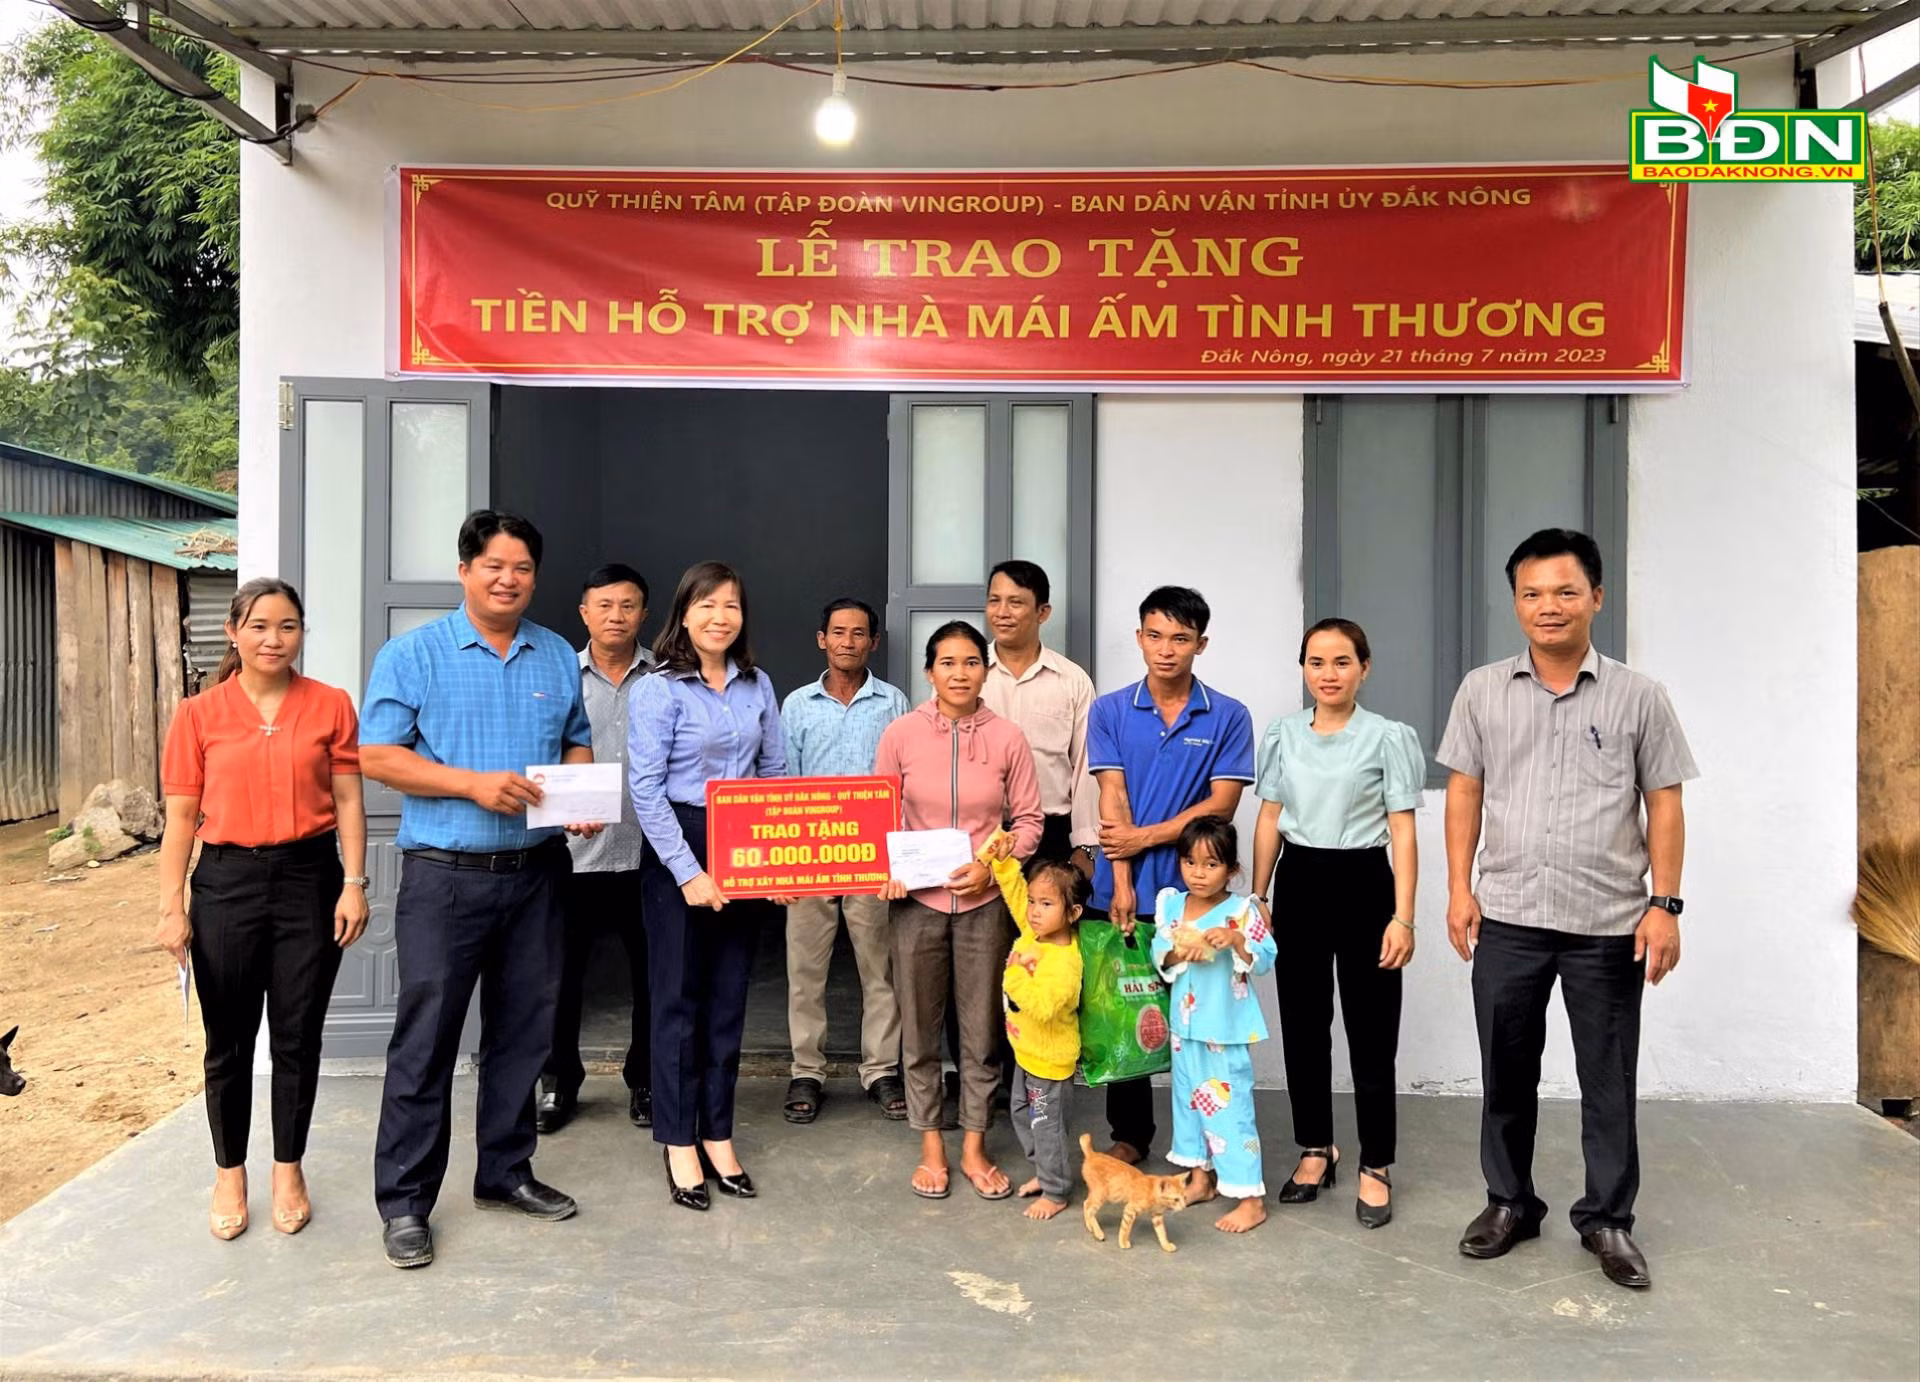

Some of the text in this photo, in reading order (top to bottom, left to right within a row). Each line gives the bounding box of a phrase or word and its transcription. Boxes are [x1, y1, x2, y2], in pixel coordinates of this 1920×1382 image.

[546, 189, 600, 210] QUỸ
[607, 189, 682, 213] THIỆN
[690, 190, 745, 212] TÂM
[754, 191, 812, 216] (TẬP
[818, 191, 893, 213] ĐOÀN
[901, 195, 1044, 216] VINGROUP)
[1071, 194, 1125, 213] BAN
[1134, 189, 1191, 212] DÂN
[1199, 189, 1256, 215] VẬN
[1264, 187, 1329, 210] TỈNH
[1338, 187, 1374, 209] ỦY
[1381, 184, 1440, 208] ĐẮK
[1448, 185, 1531, 206] NÔNG
[756, 218, 1304, 289] LỄ TRAO TẶNG
[471, 287, 1606, 345] TIỀN HỖ TRỢ NHÀ MÁI ẤM TÌNH THƯƠNG
[1200, 348, 1607, 367] Đắk Nông, ngày 21 tháng 7 năm 2023
[751, 819, 859, 840] TRAO TẶNG
[731, 843, 876, 868] 60.000.000Đ
